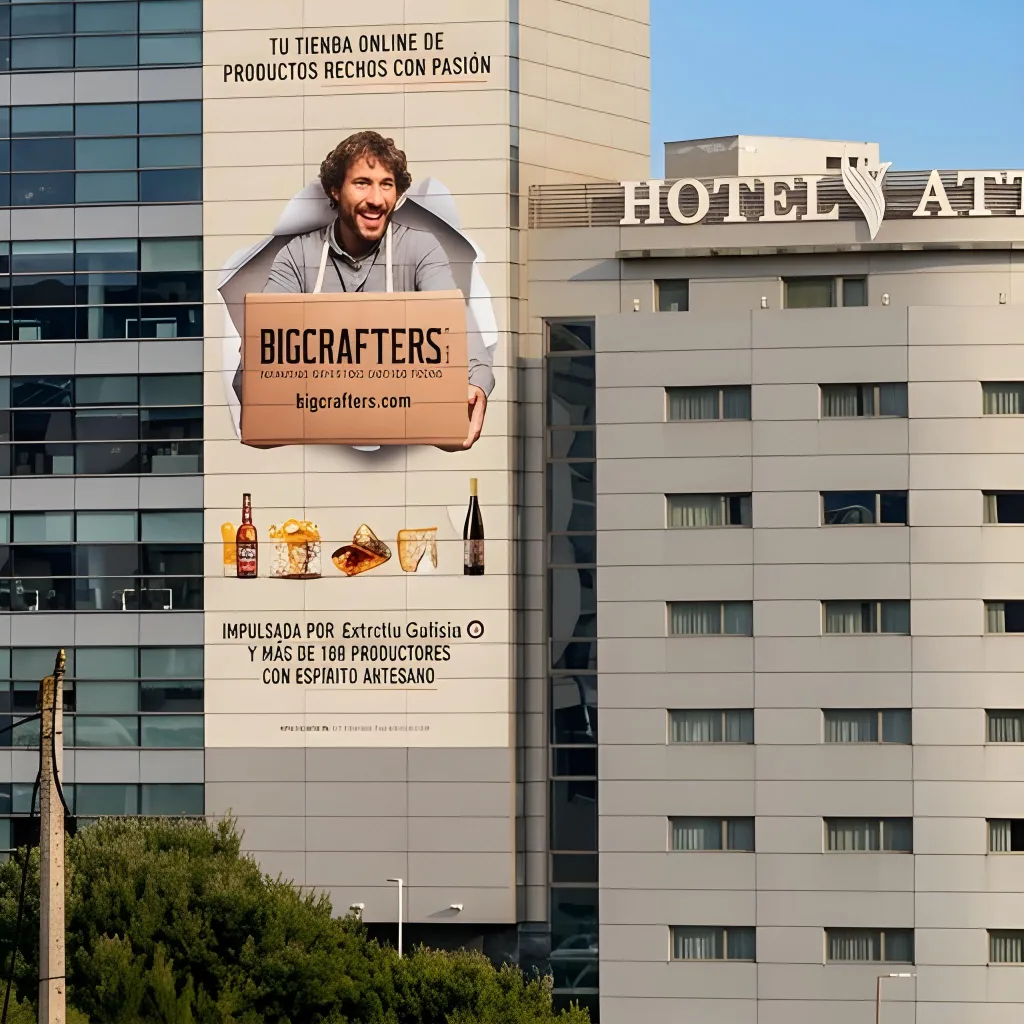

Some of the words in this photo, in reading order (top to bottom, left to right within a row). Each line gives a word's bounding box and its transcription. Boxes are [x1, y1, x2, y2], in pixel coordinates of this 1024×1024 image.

[269, 37, 289, 56] TU
[358, 33, 418, 53] ONLINE
[423, 32, 444, 51] DE
[223, 62, 318, 83] PRODUCTOS
[392, 57, 426, 77] CON
[432, 51, 491, 76] PASIÓN
[619, 175, 839, 225] HOTEL
[260, 327, 442, 365] BIGCRAFTERS
[296, 392, 411, 413] bigcrafters.com
[222, 622, 302, 640] IMPULSADA
[306, 622, 335, 639] POR
[247, 645, 258, 662] Y
[262, 640, 293, 662] MÁS
[297, 644, 315, 662] DE
[351, 644, 451, 662] PRODUCTORES
[262, 667, 290, 685] CON
